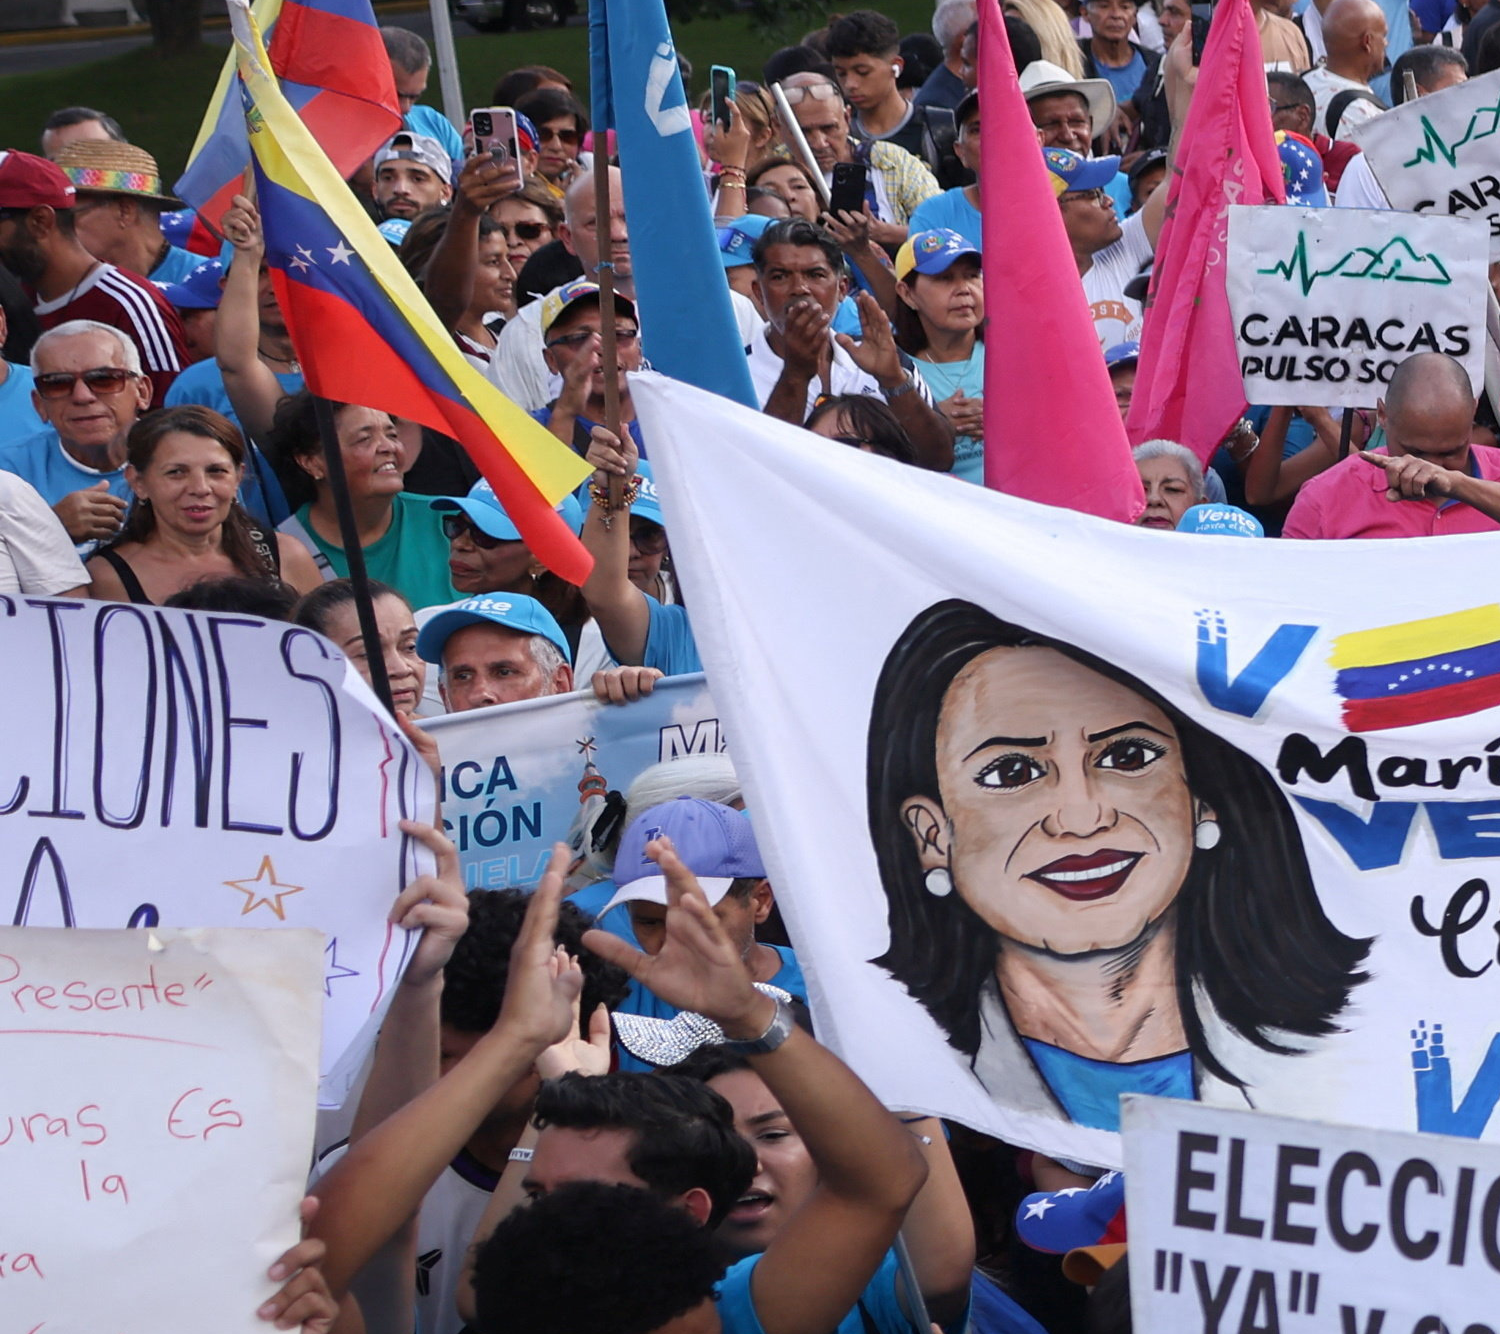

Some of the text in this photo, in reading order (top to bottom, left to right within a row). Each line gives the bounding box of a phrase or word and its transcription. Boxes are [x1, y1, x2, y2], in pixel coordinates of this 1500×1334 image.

[1239, 314, 1474, 358] CARACAS
[1241, 354, 1351, 385] PULSO
[1199, 506, 1257, 532] Vente
